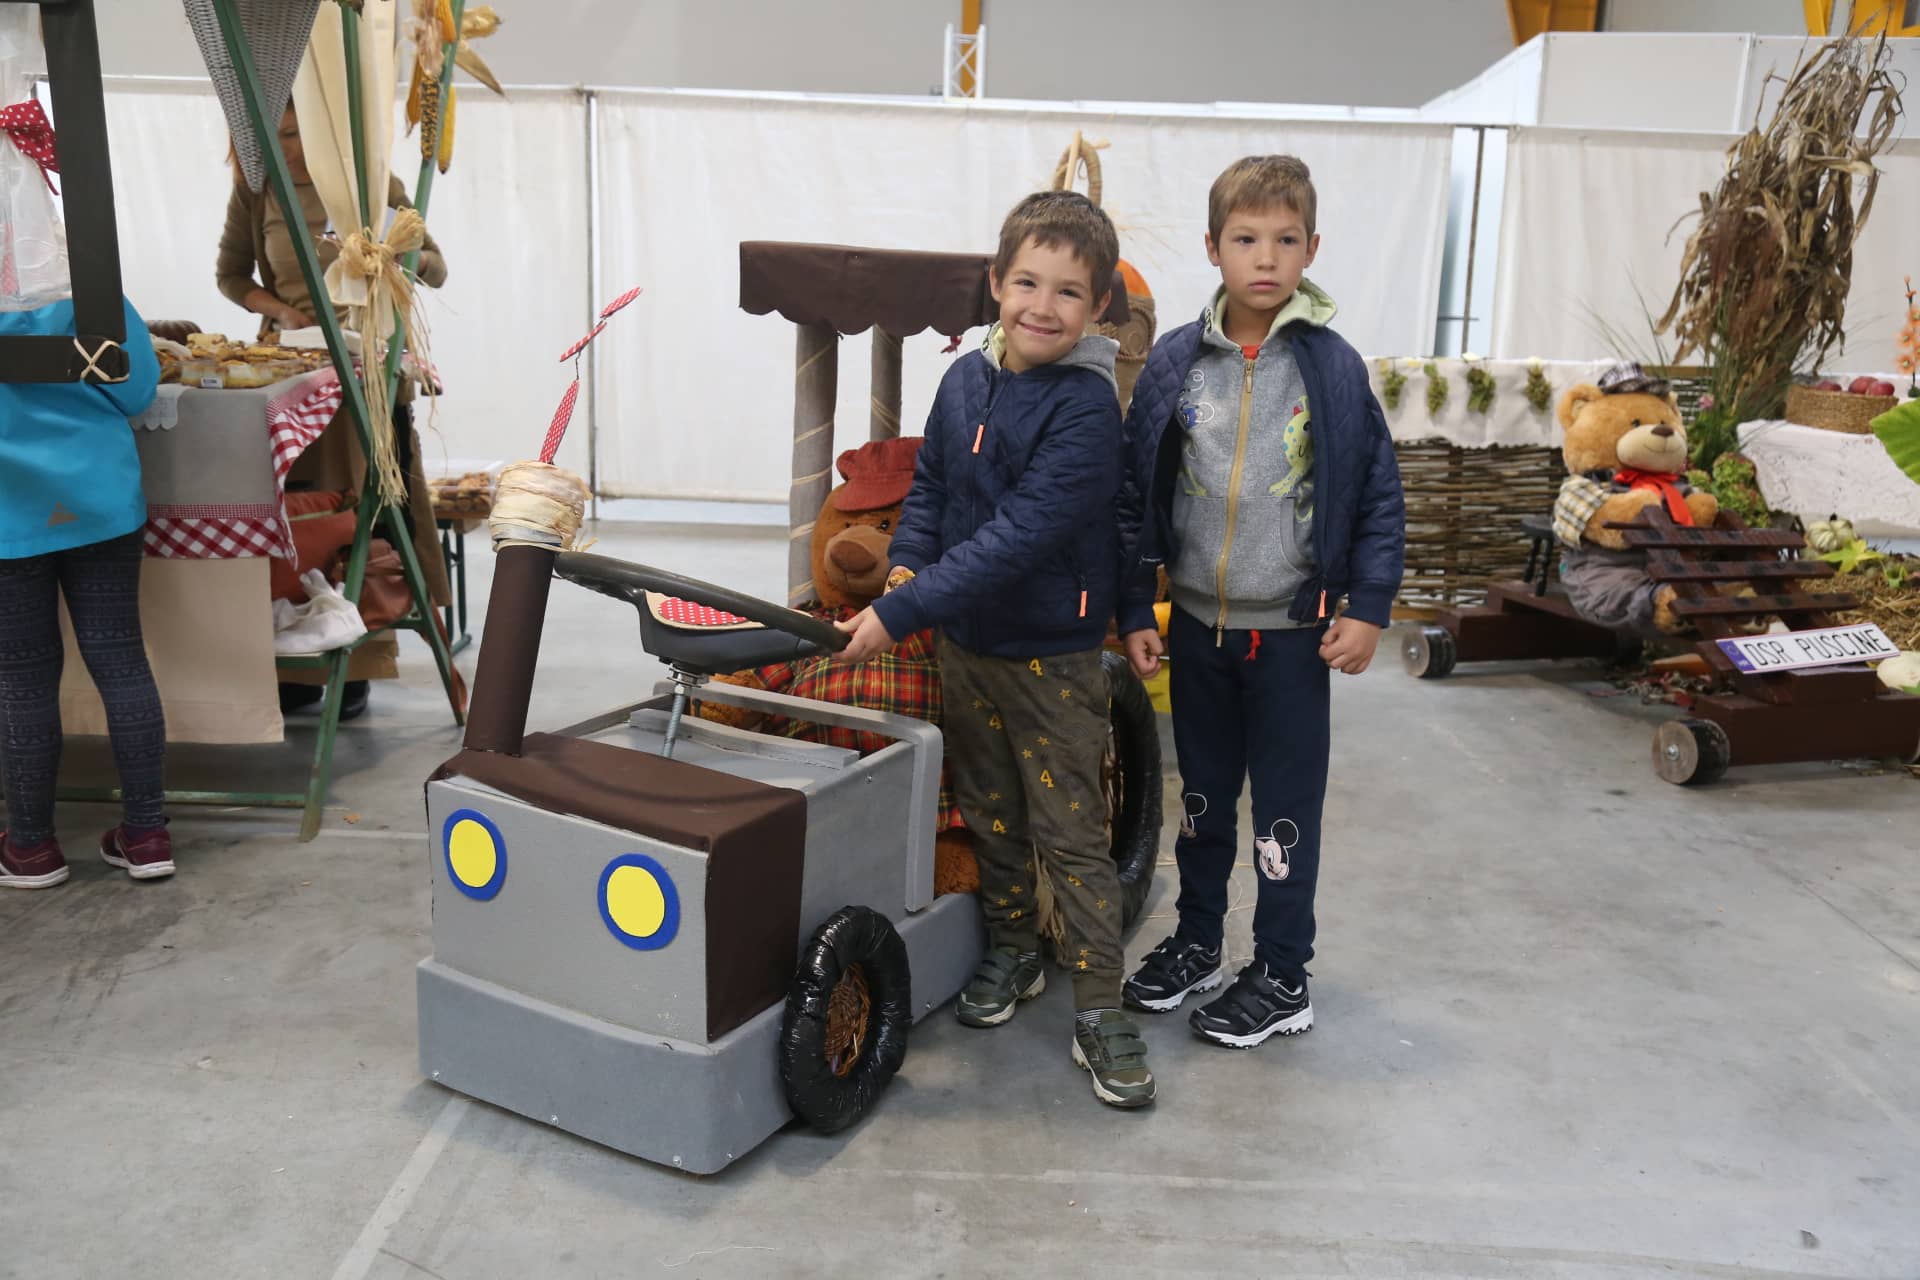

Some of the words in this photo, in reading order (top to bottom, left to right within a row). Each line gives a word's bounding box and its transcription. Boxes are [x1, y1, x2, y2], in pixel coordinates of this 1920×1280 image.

[1744, 641, 1793, 666] DSR
[1028, 657, 1044, 677] 4
[1039, 769, 1055, 788] 4
